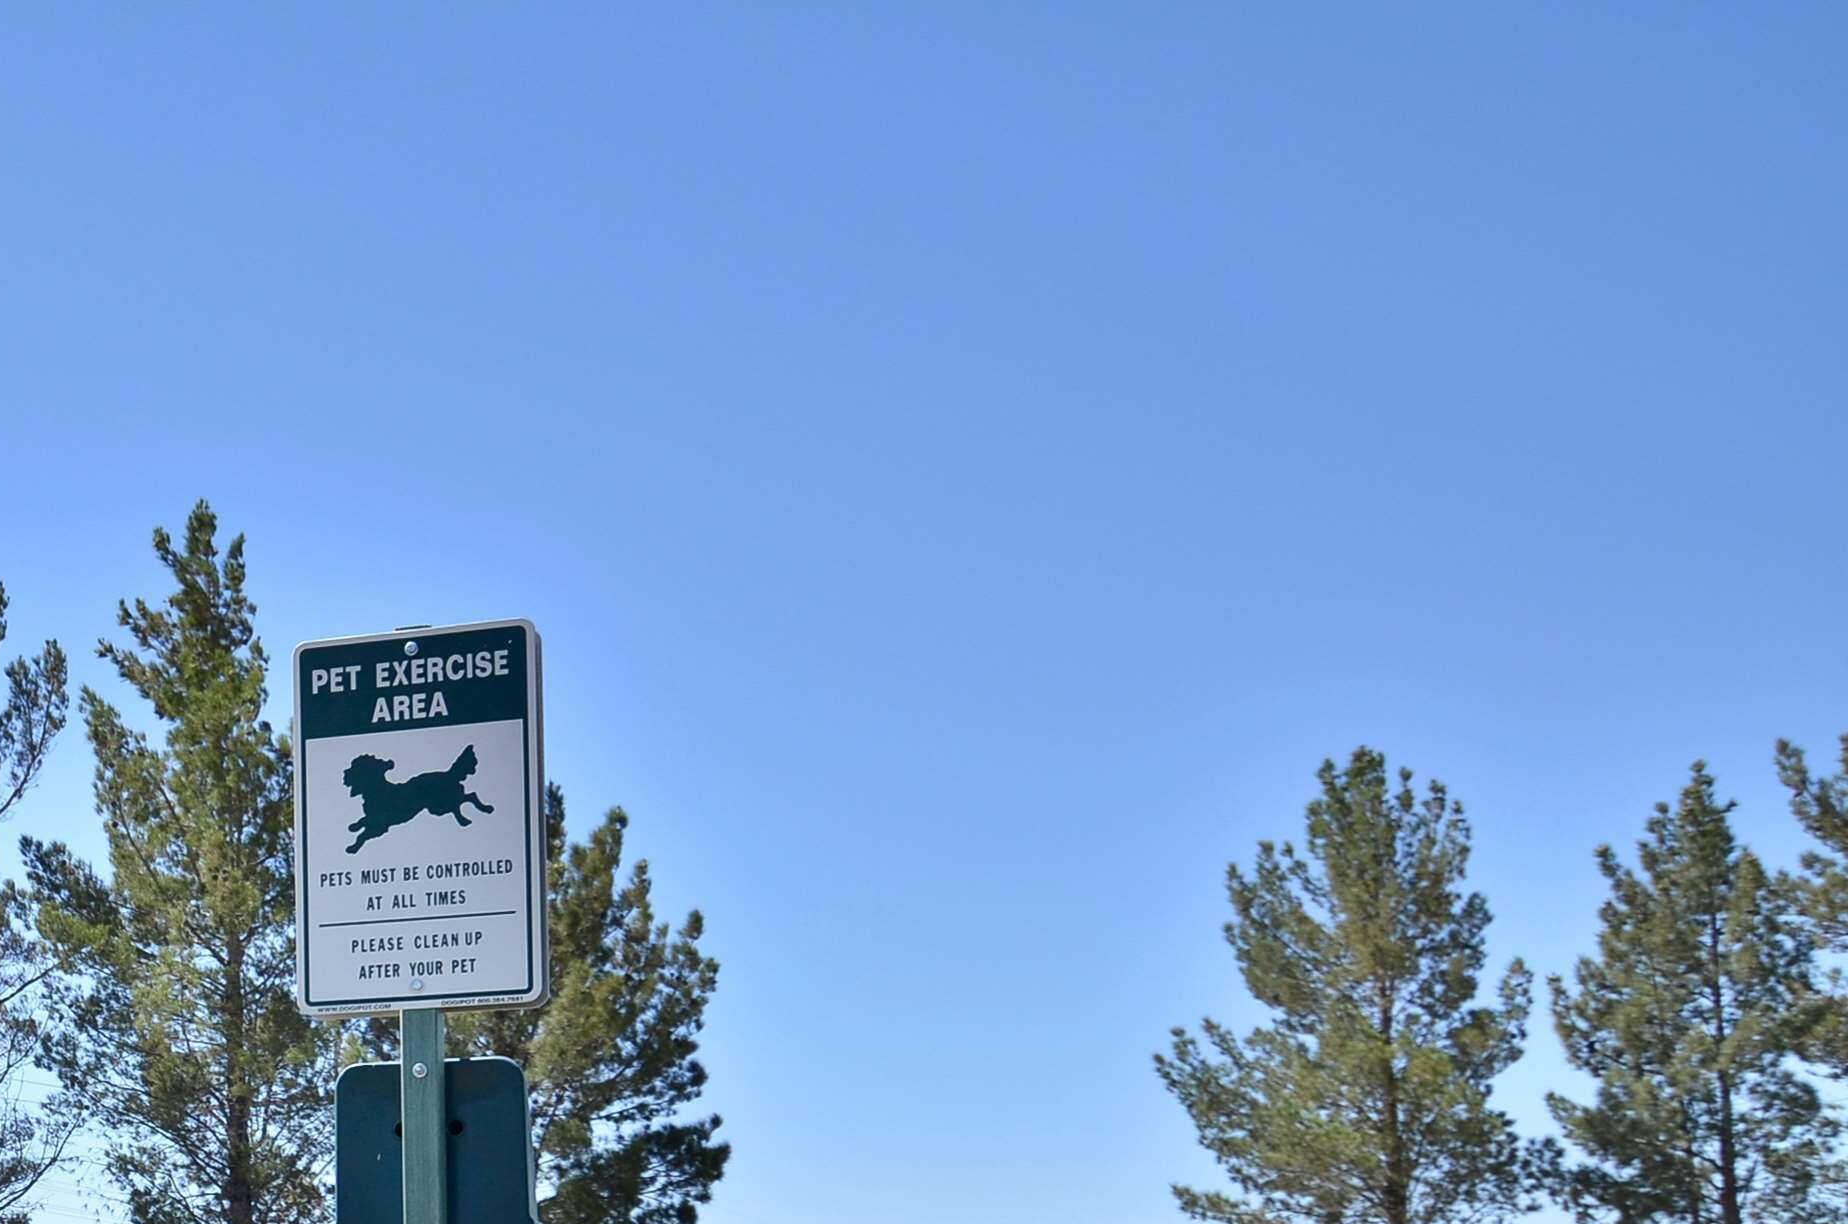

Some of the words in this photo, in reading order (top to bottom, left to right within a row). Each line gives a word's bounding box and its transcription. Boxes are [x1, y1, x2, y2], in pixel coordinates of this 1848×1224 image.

[311, 665, 361, 695] PET
[375, 649, 509, 689] EXERCISE
[371, 691, 449, 723] AREA
[320, 871, 352, 888] PETS
[360, 868, 396, 885] MUST
[403, 866, 420, 881] BE
[426, 859, 513, 879] CONTROLLED
[366, 895, 383, 911] AT
[392, 893, 417, 909] ALL
[425, 889, 466, 907] TIMES
[351, 936, 404, 953] PLEASE
[414, 932, 459, 949] CLEAN
[464, 931, 483, 946] UP
[358, 963, 401, 980] AFTER
[409, 960, 443, 977] YOUR
[451, 958, 477, 974] PET
